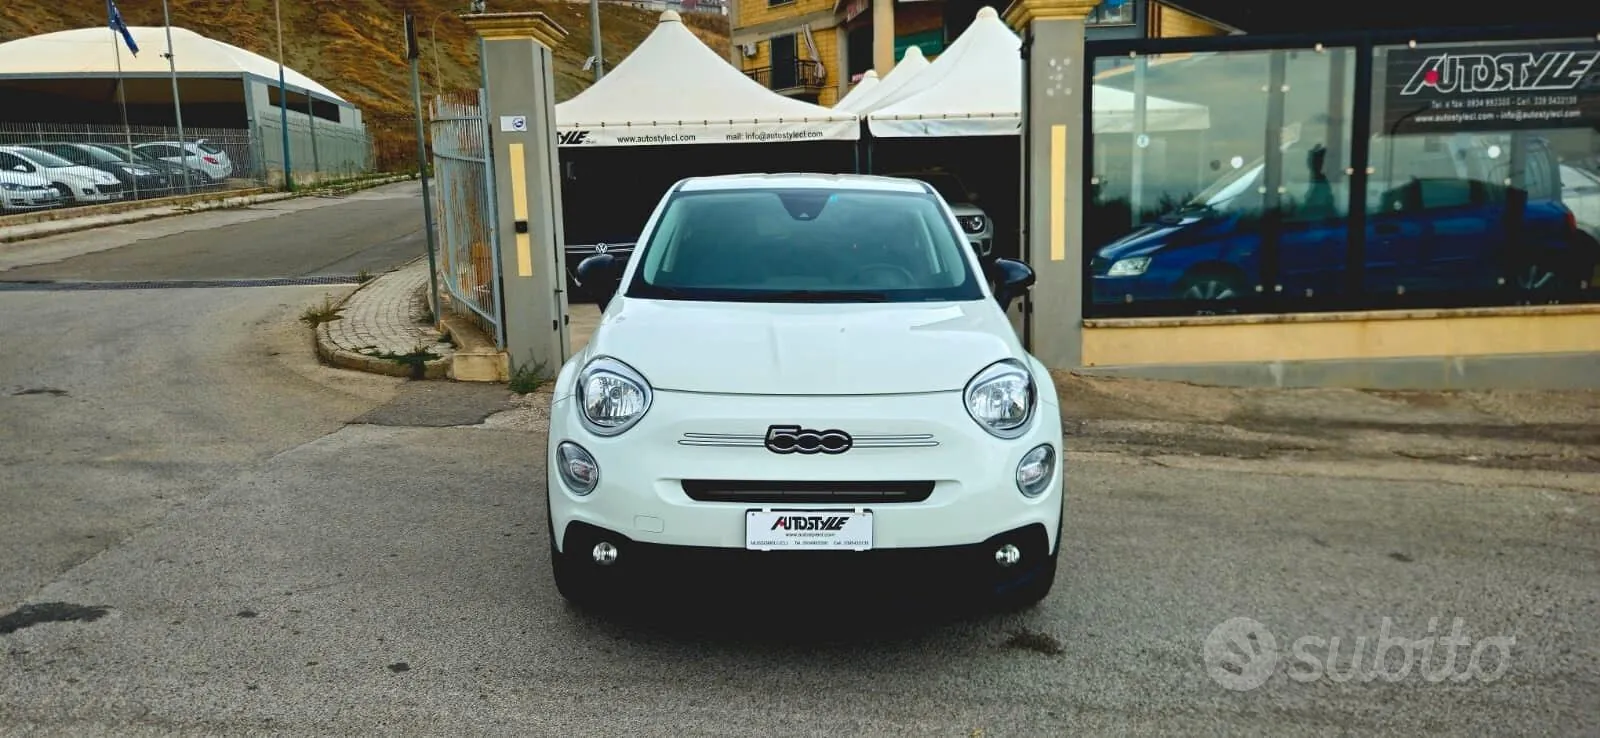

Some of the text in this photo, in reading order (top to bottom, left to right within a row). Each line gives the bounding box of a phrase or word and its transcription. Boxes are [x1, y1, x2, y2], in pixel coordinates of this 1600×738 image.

[1400, 52, 1600, 95] AUTOSTYLE
[617, 133, 696, 144] www.autostylecl.com
[745, 130, 823, 142] info@autostylecl.com
[765, 425, 853, 455] 500
[771, 516, 850, 530] AUTOSTYLE
